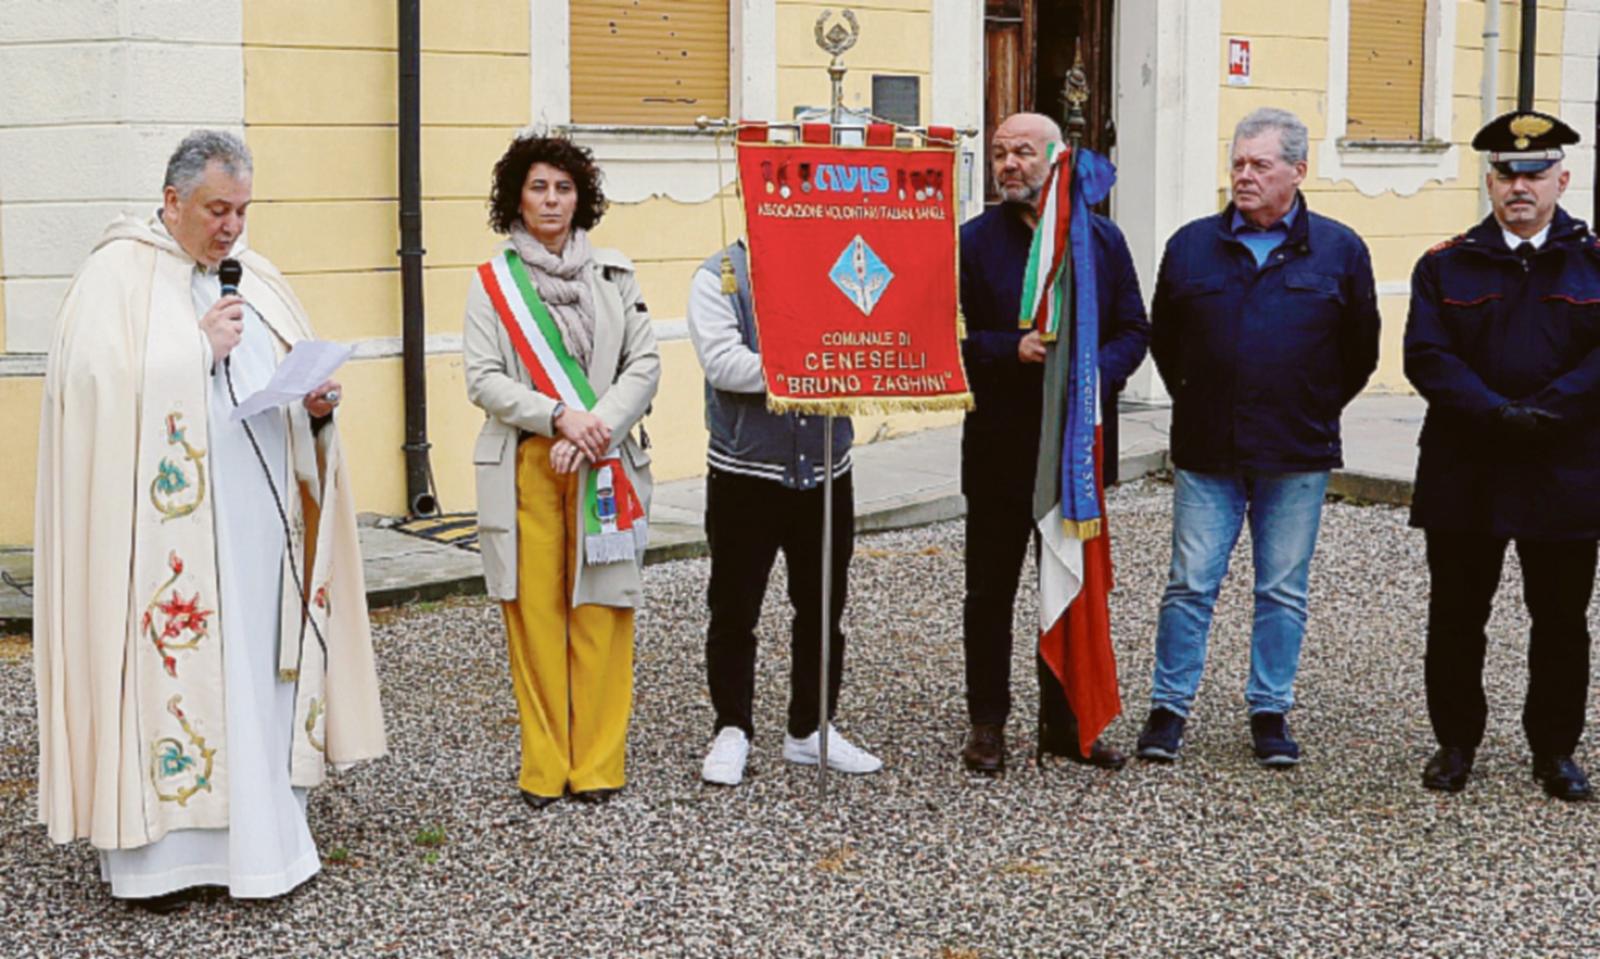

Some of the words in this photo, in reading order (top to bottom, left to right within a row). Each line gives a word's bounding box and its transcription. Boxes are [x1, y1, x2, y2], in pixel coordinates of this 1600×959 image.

[814, 163, 890, 193] AVIS
[821, 331, 894, 346] COMUNALE
[899, 331, 911, 345] DI
[805, 351, 926, 370] CENESELLI
